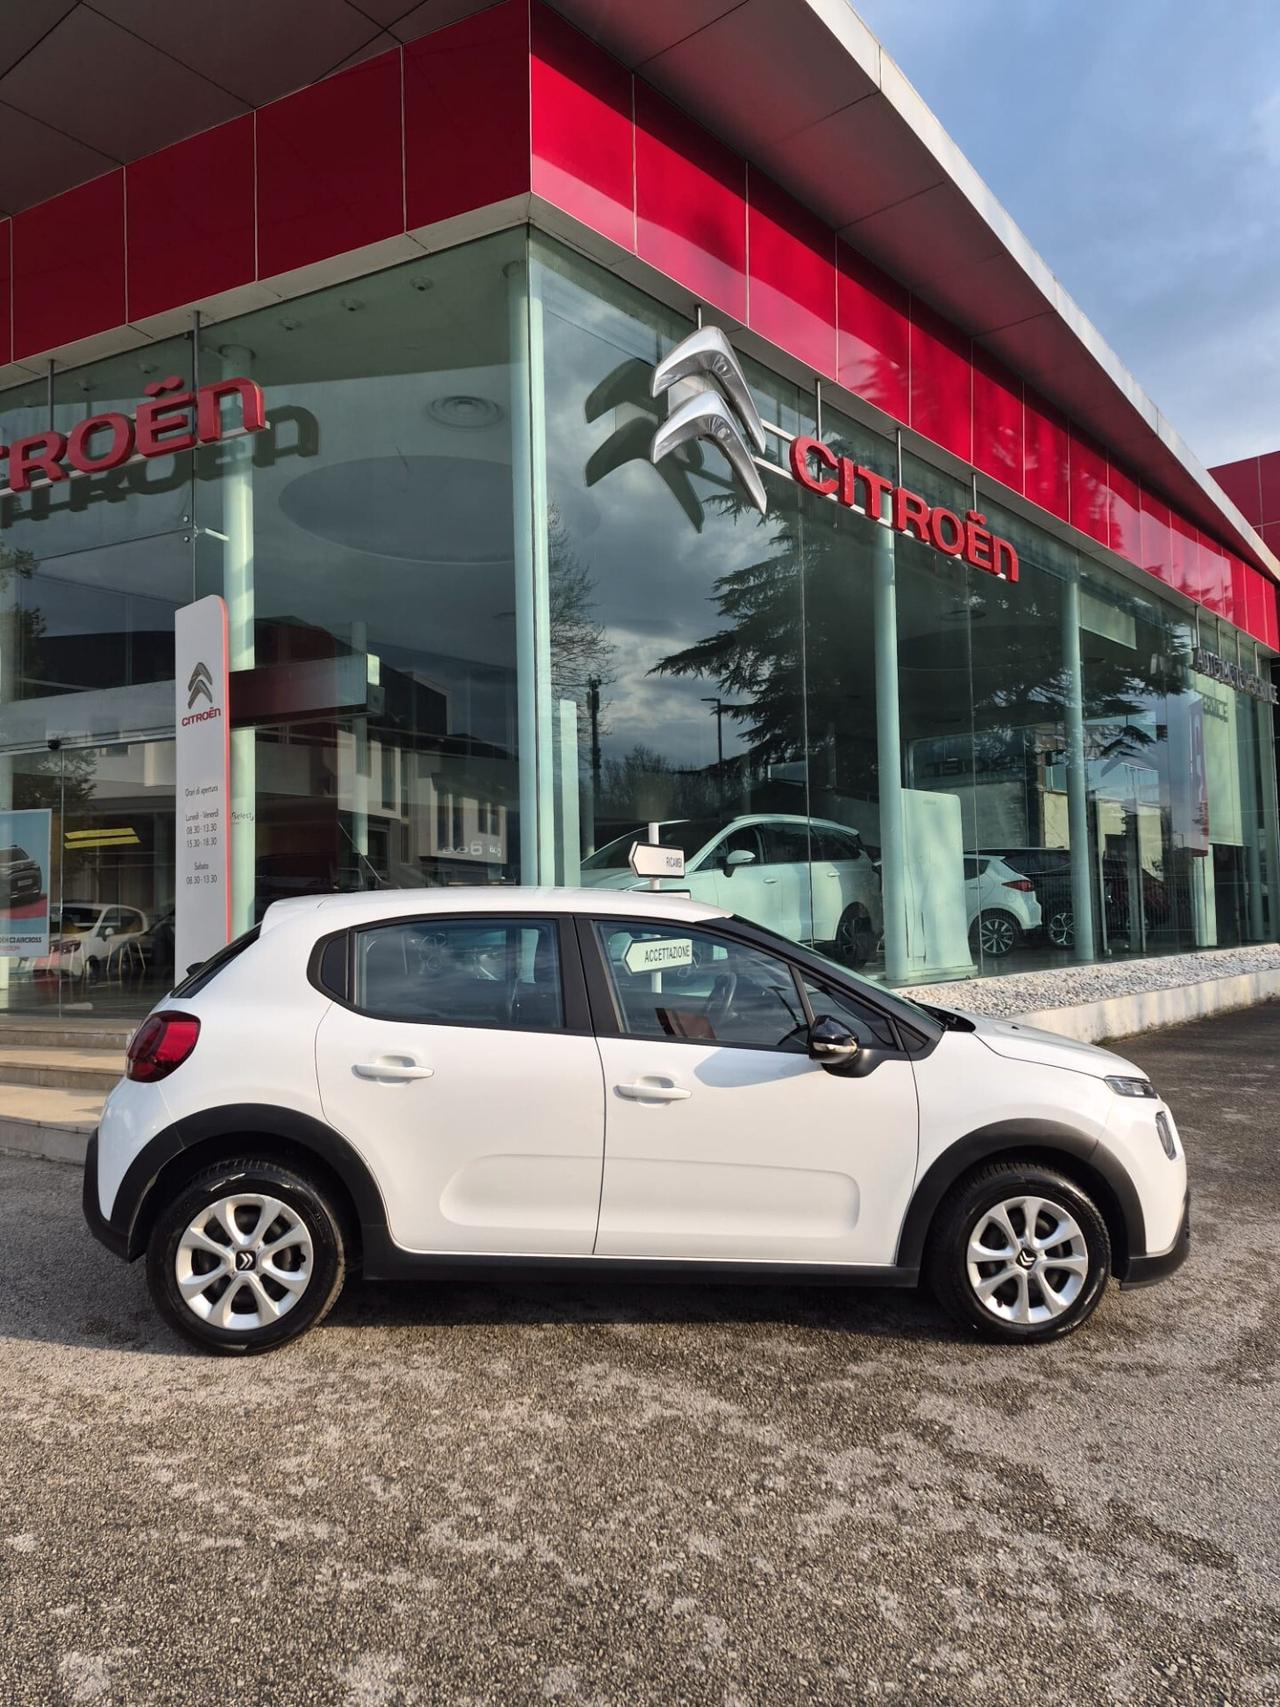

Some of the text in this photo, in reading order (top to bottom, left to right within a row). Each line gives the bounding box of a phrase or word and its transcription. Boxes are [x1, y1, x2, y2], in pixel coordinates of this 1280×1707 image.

[0, 375, 267, 493] ROËN
[666, 856, 682, 868] RICAMBI
[644, 944, 690, 963] ACCETTAZIONE
